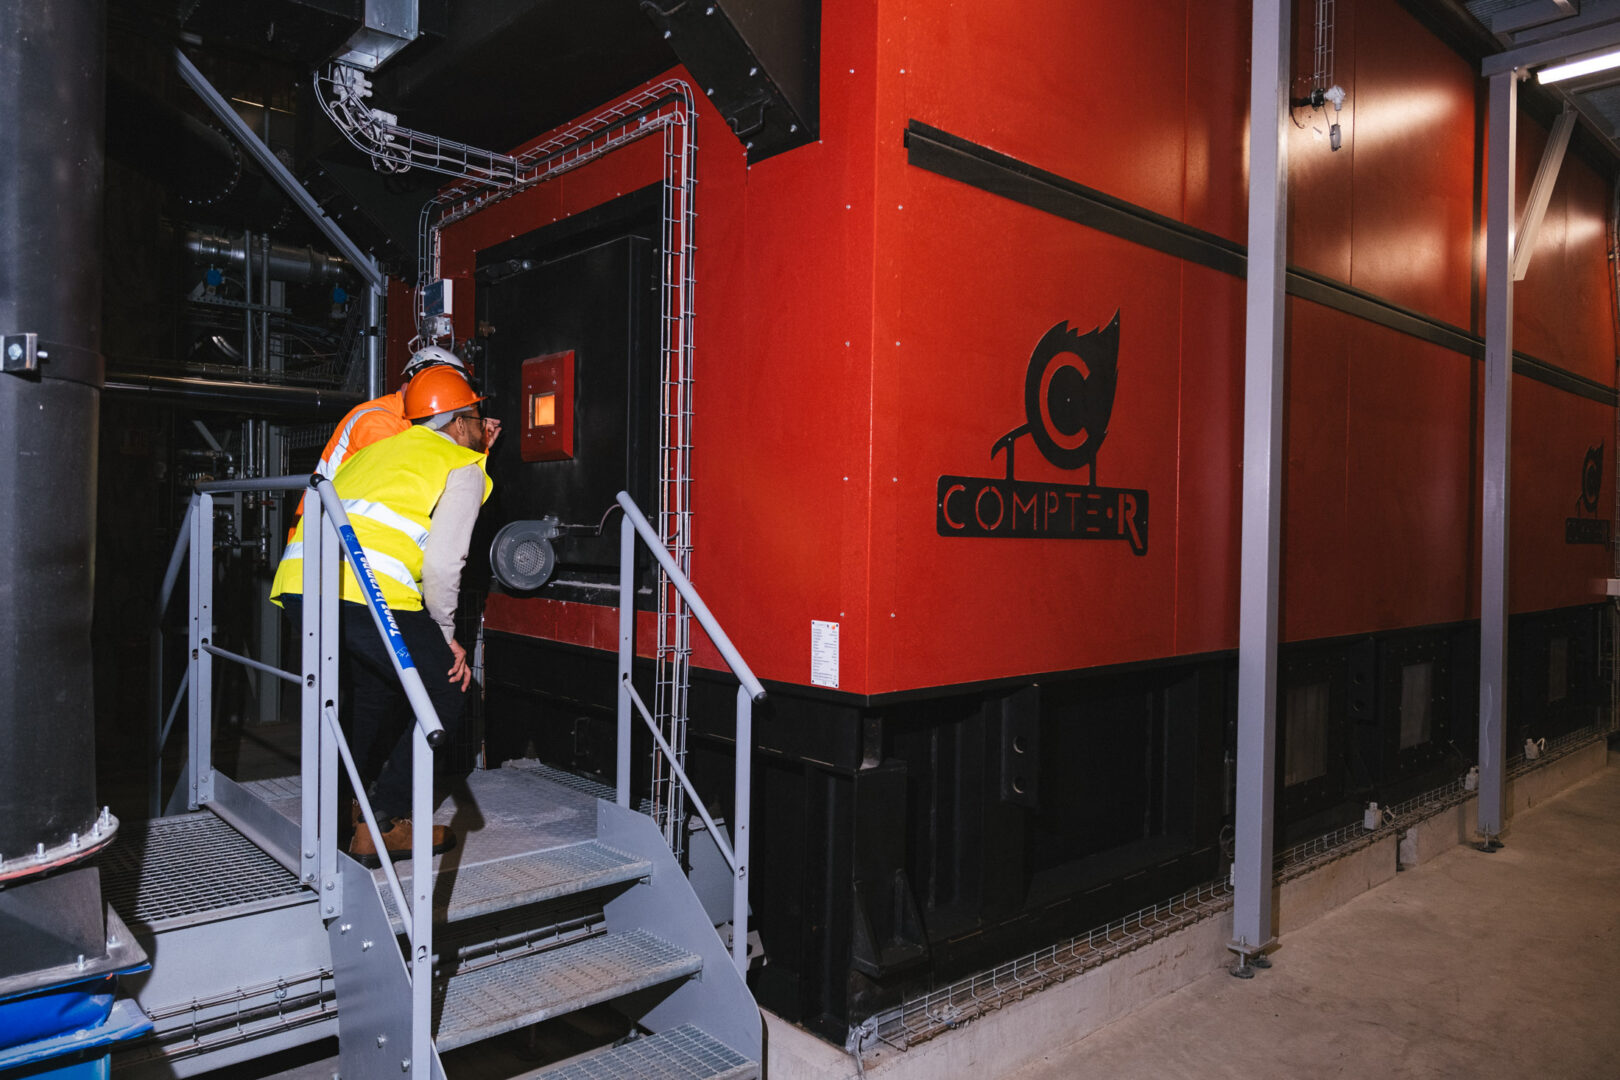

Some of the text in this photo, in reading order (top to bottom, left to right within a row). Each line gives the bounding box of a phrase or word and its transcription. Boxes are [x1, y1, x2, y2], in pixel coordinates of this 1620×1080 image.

[1039, 351, 1091, 450] C
[376, 588, 386, 602] la
[381, 602, 402, 637] Tenez
